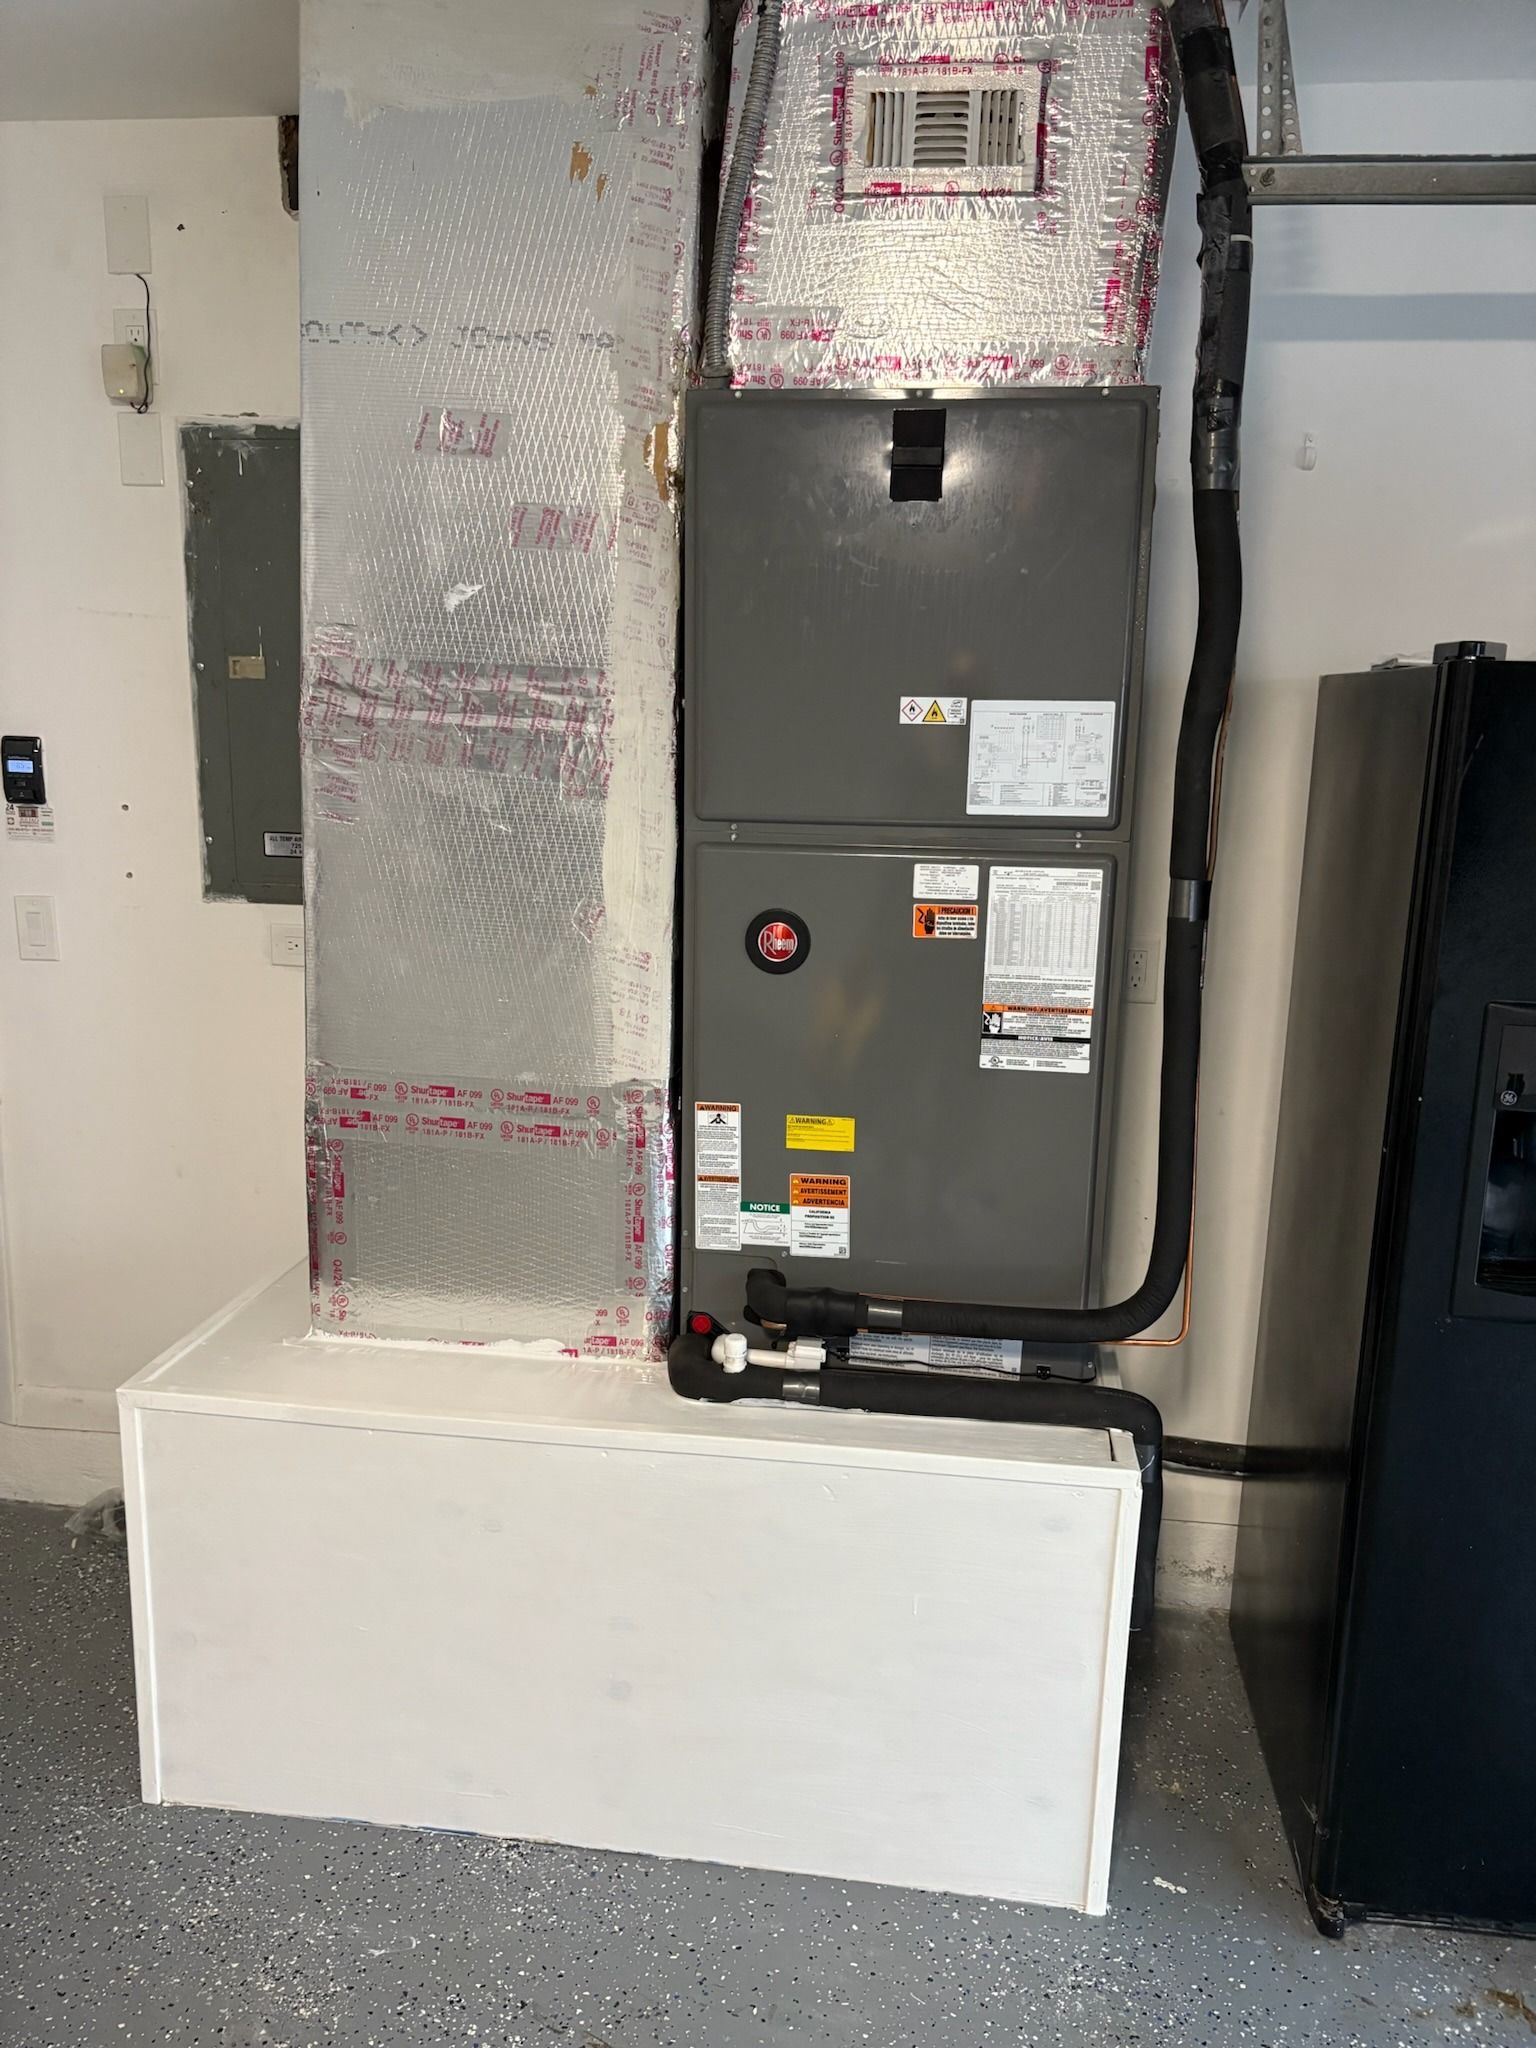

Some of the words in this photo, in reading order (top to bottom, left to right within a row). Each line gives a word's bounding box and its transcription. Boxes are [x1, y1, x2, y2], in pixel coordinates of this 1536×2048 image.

[764, 930, 794, 955] Rheem
[373, 1083, 387, 1092] 099
[411, 1085, 449, 1099] Shurtape
[457, 1089, 469, 1098] AF
[469, 1090, 483, 1099] 099
[507, 1091, 546, 1105] Shurtape
[564, 1098, 579, 1106] 099
[412, 1097, 437, 1106] 181A-P
[444, 1099, 475, 1108] 181B-FX
[372, 1114, 384, 1122] AF
[385, 1115, 398, 1124] 099
[422, 1116, 461, 1130] Shurtape
[467, 1121, 479, 1129] AF
[479, 1121, 493, 1131] 099
[516, 1123, 556, 1137] Shurtape
[563, 1129, 574, 1137] AF
[575, 1130, 588, 1139] 099
[795, 1117, 827, 1126] WARNING
[422, 1128, 448, 1137] 181A-P
[455, 1131, 485, 1140] 181B-FX
[517, 1136, 543, 1144] 181A-P
[637, 1150, 644, 1160] AF
[635, 1161, 644, 1176] 099
[800, 1177, 846, 1185] WARNING
[750, 1203, 780, 1212] NOTICE
[803, 1198, 845, 1206] ADVERTENCIA
[624, 1199, 632, 1224] 181A-P
[336, 1211, 344, 1225] 099
[633, 1199, 644, 1237] Shurtape
[624, 1231, 632, 1262] 181B-FX
[635, 1244, 643, 1255] AF
[634, 1255, 643, 1270] 099
[332, 1259, 343, 1287] Q4/24
[619, 1338, 630, 1346] AF
[630, 1338, 644, 1347] 099
[607, 1348, 636, 1356] 181B-FX
